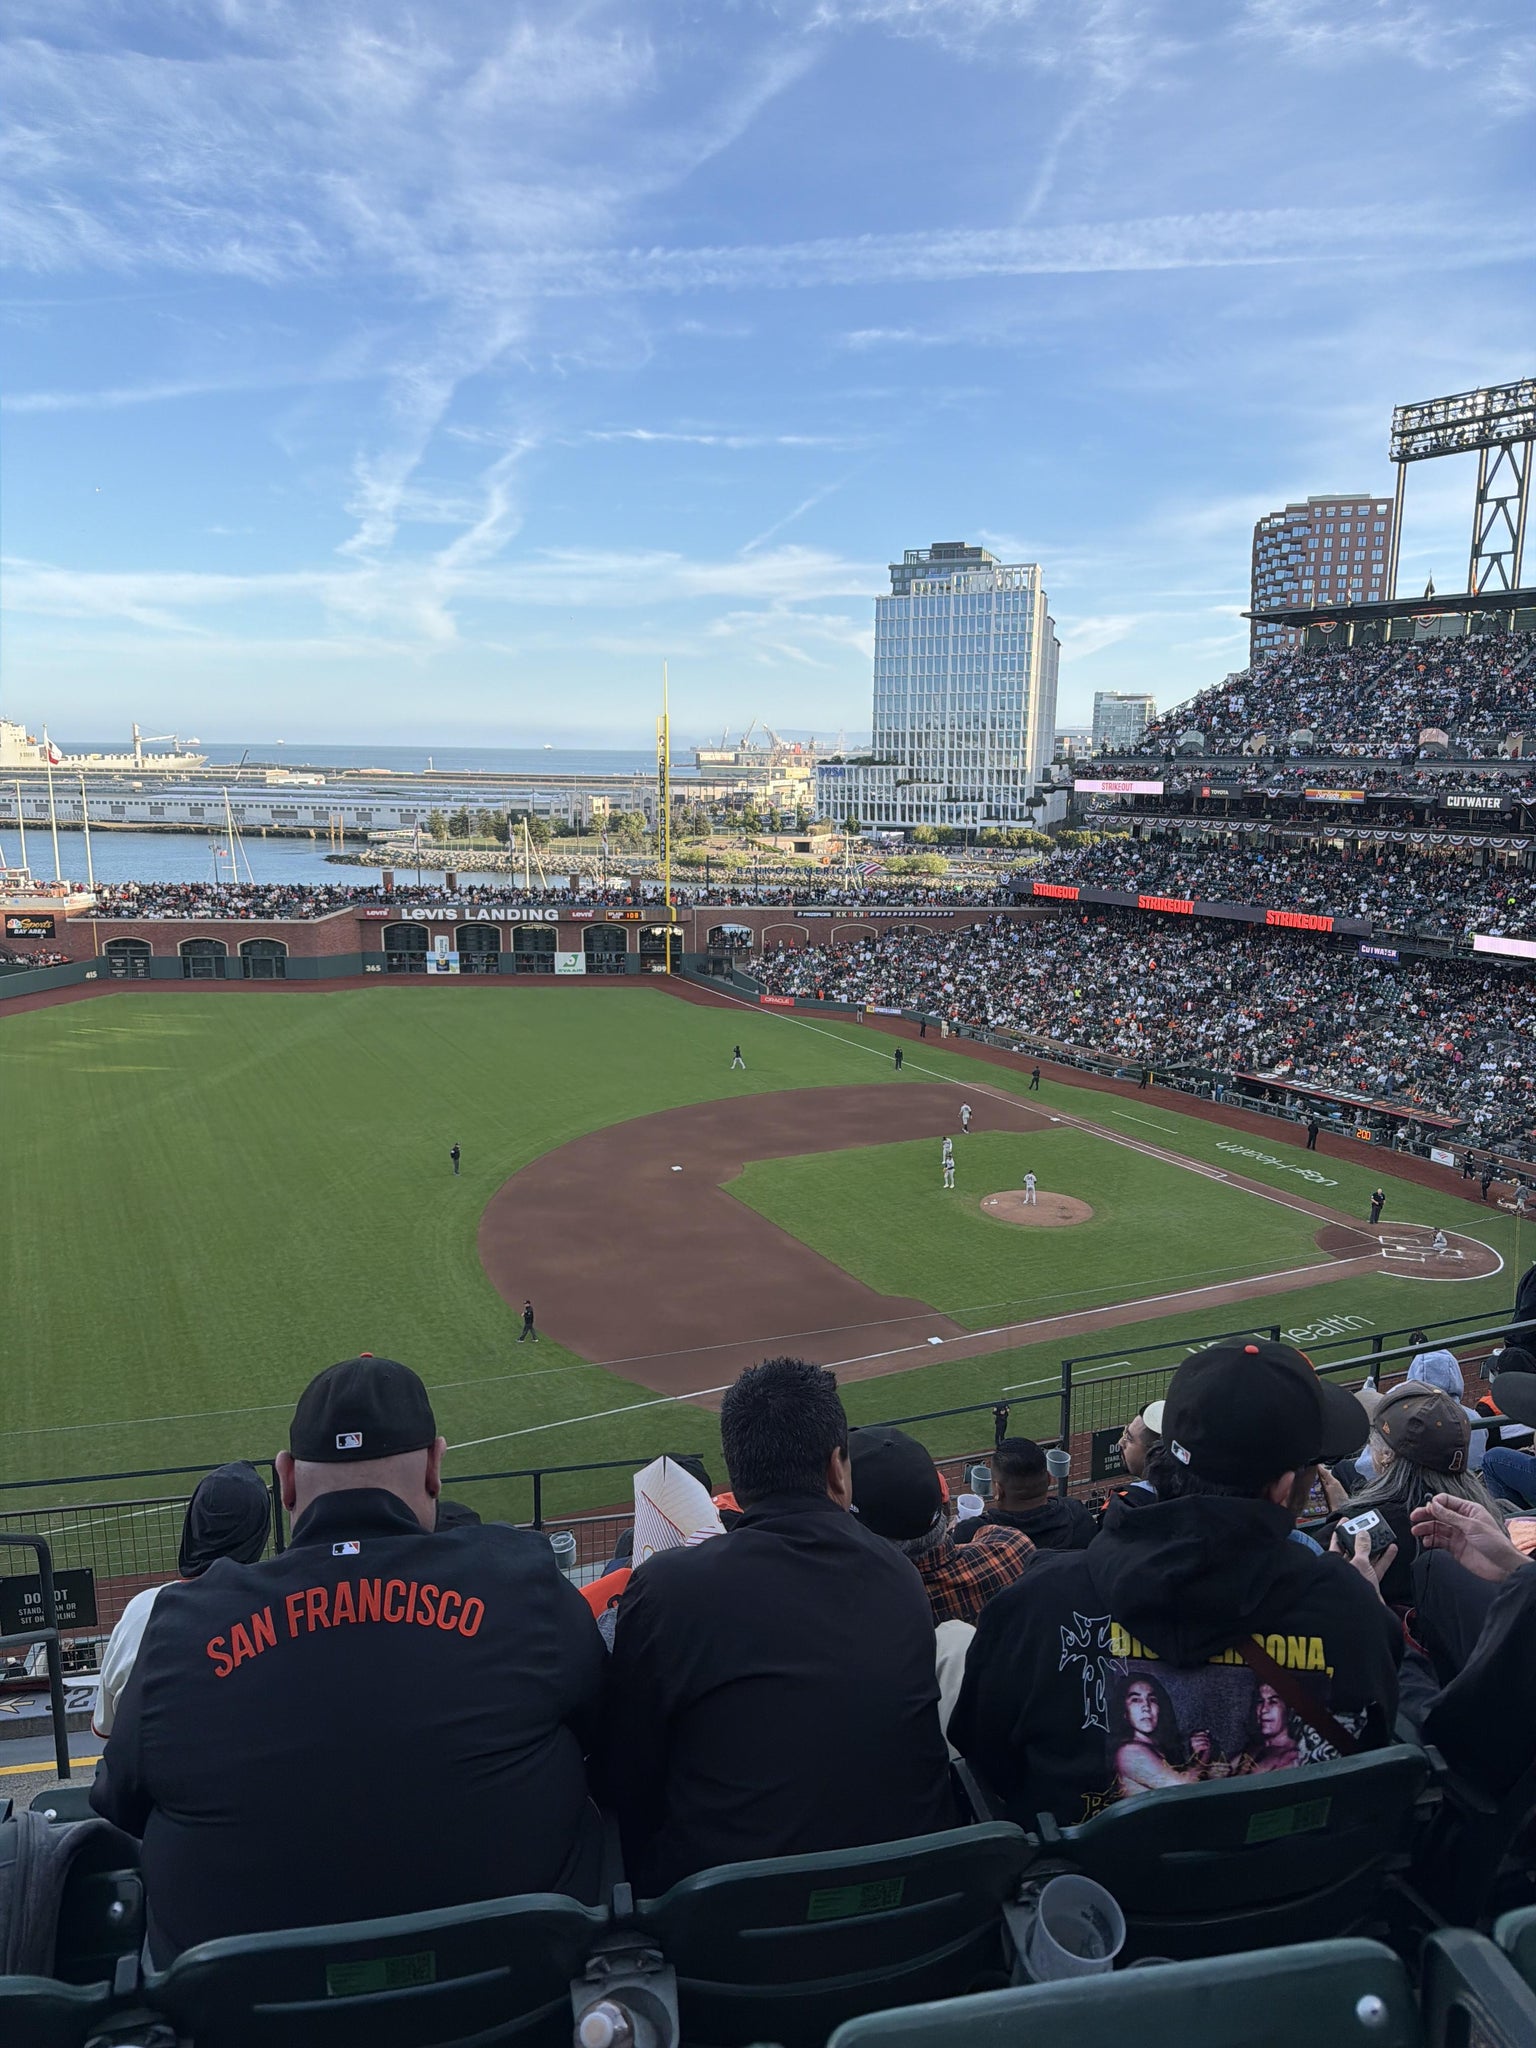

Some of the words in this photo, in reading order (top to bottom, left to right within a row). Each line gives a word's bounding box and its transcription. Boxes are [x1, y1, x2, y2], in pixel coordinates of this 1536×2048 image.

[1101, 782, 1133, 792] STRIKEOUT
[1447, 796, 1501, 809] CUTWATER
[737, 867, 771, 875] BANK
[776, 867, 792, 875] OF
[795, 867, 855, 875] AMERICA
[1033, 883, 1080, 900] STRIKEOUT
[1138, 895, 1195, 915] STRIKEOUT
[465, 908, 559, 921] LANDING
[1266, 910, 1335, 932] STRIKEOUT
[20, 918, 53, 930] Sports
[1361, 944, 1397, 957] CUTWATER
[85, 971, 97, 979] 415
[651, 965, 666, 973] 309
[23, 1592, 42, 1605] DO
[53, 1589, 69, 1602] OT
[66, 1602, 77, 1611] OR
[20, 1616, 32, 1625] SIT
[34, 1615, 45, 1624] ON
[56, 1611, 77, 1621] ILING
[206, 1606, 277, 1677] SAN
[286, 1578, 485, 1637] FRANCISCO
